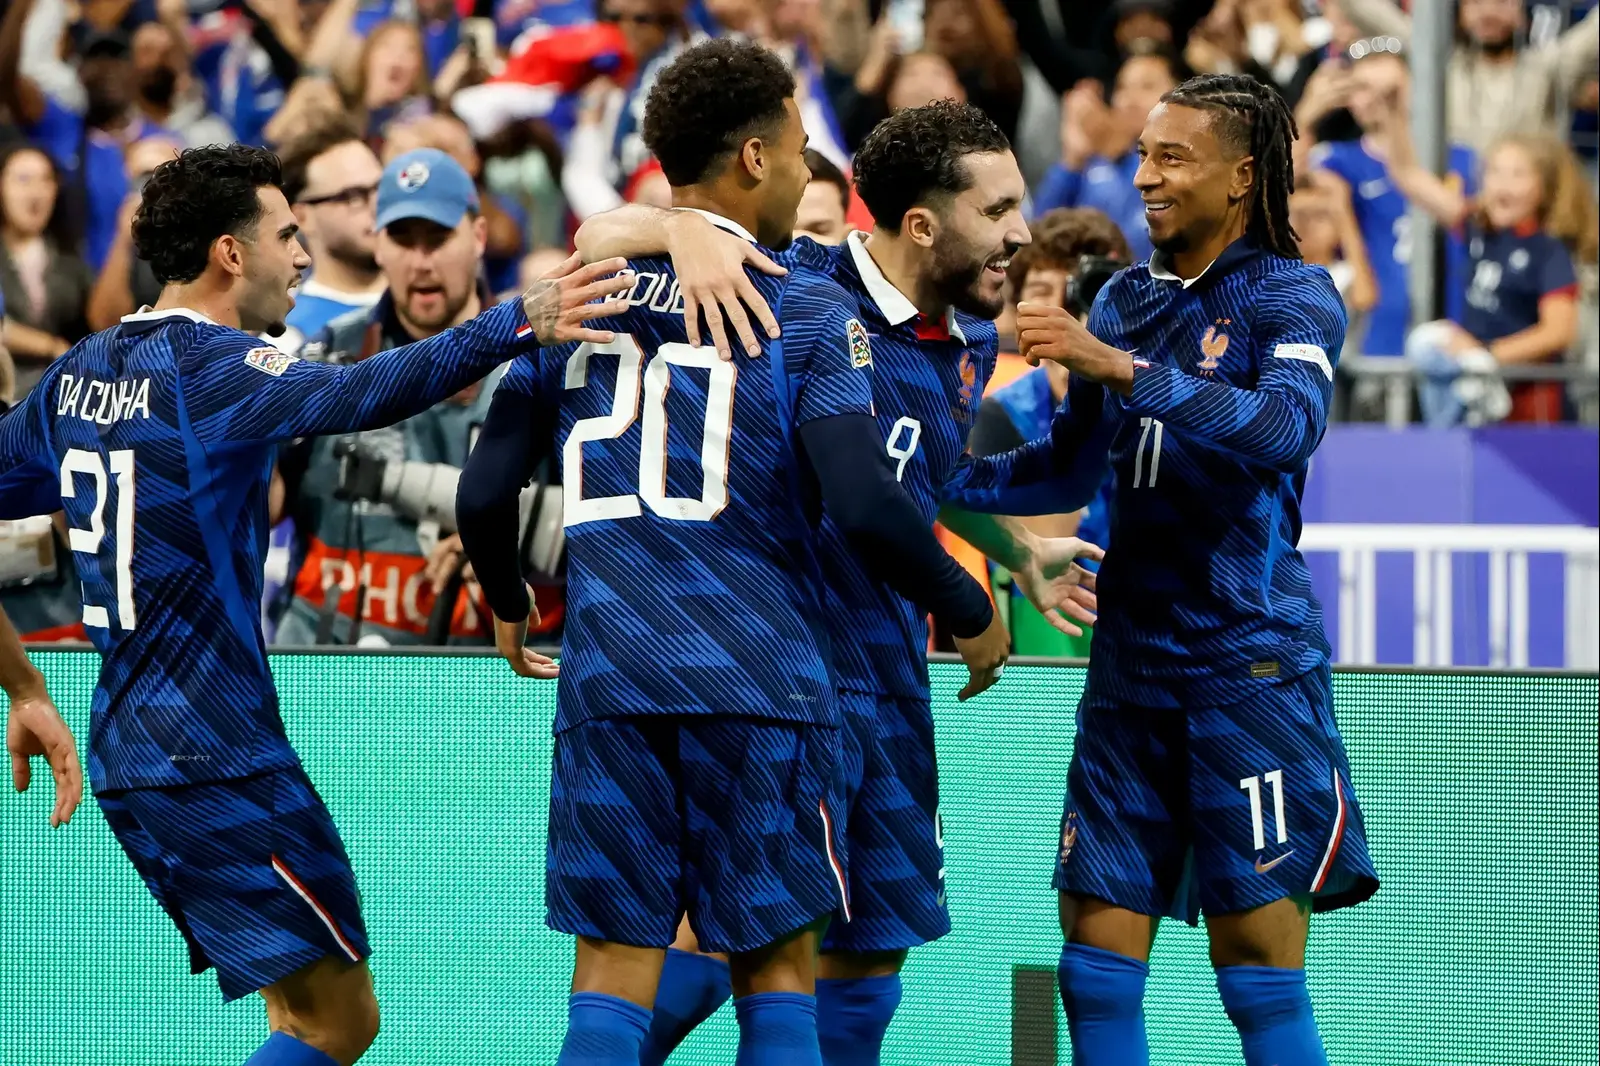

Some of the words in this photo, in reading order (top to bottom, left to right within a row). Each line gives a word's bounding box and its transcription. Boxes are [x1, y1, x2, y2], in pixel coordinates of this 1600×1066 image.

[57, 374, 84, 416] DA
[80, 379, 150, 425] CUNHA
[563, 332, 738, 528] 20
[886, 415, 921, 482] 9
[1133, 417, 1164, 489] 11
[60, 448, 136, 630] 21
[1240, 769, 1288, 851] 11
